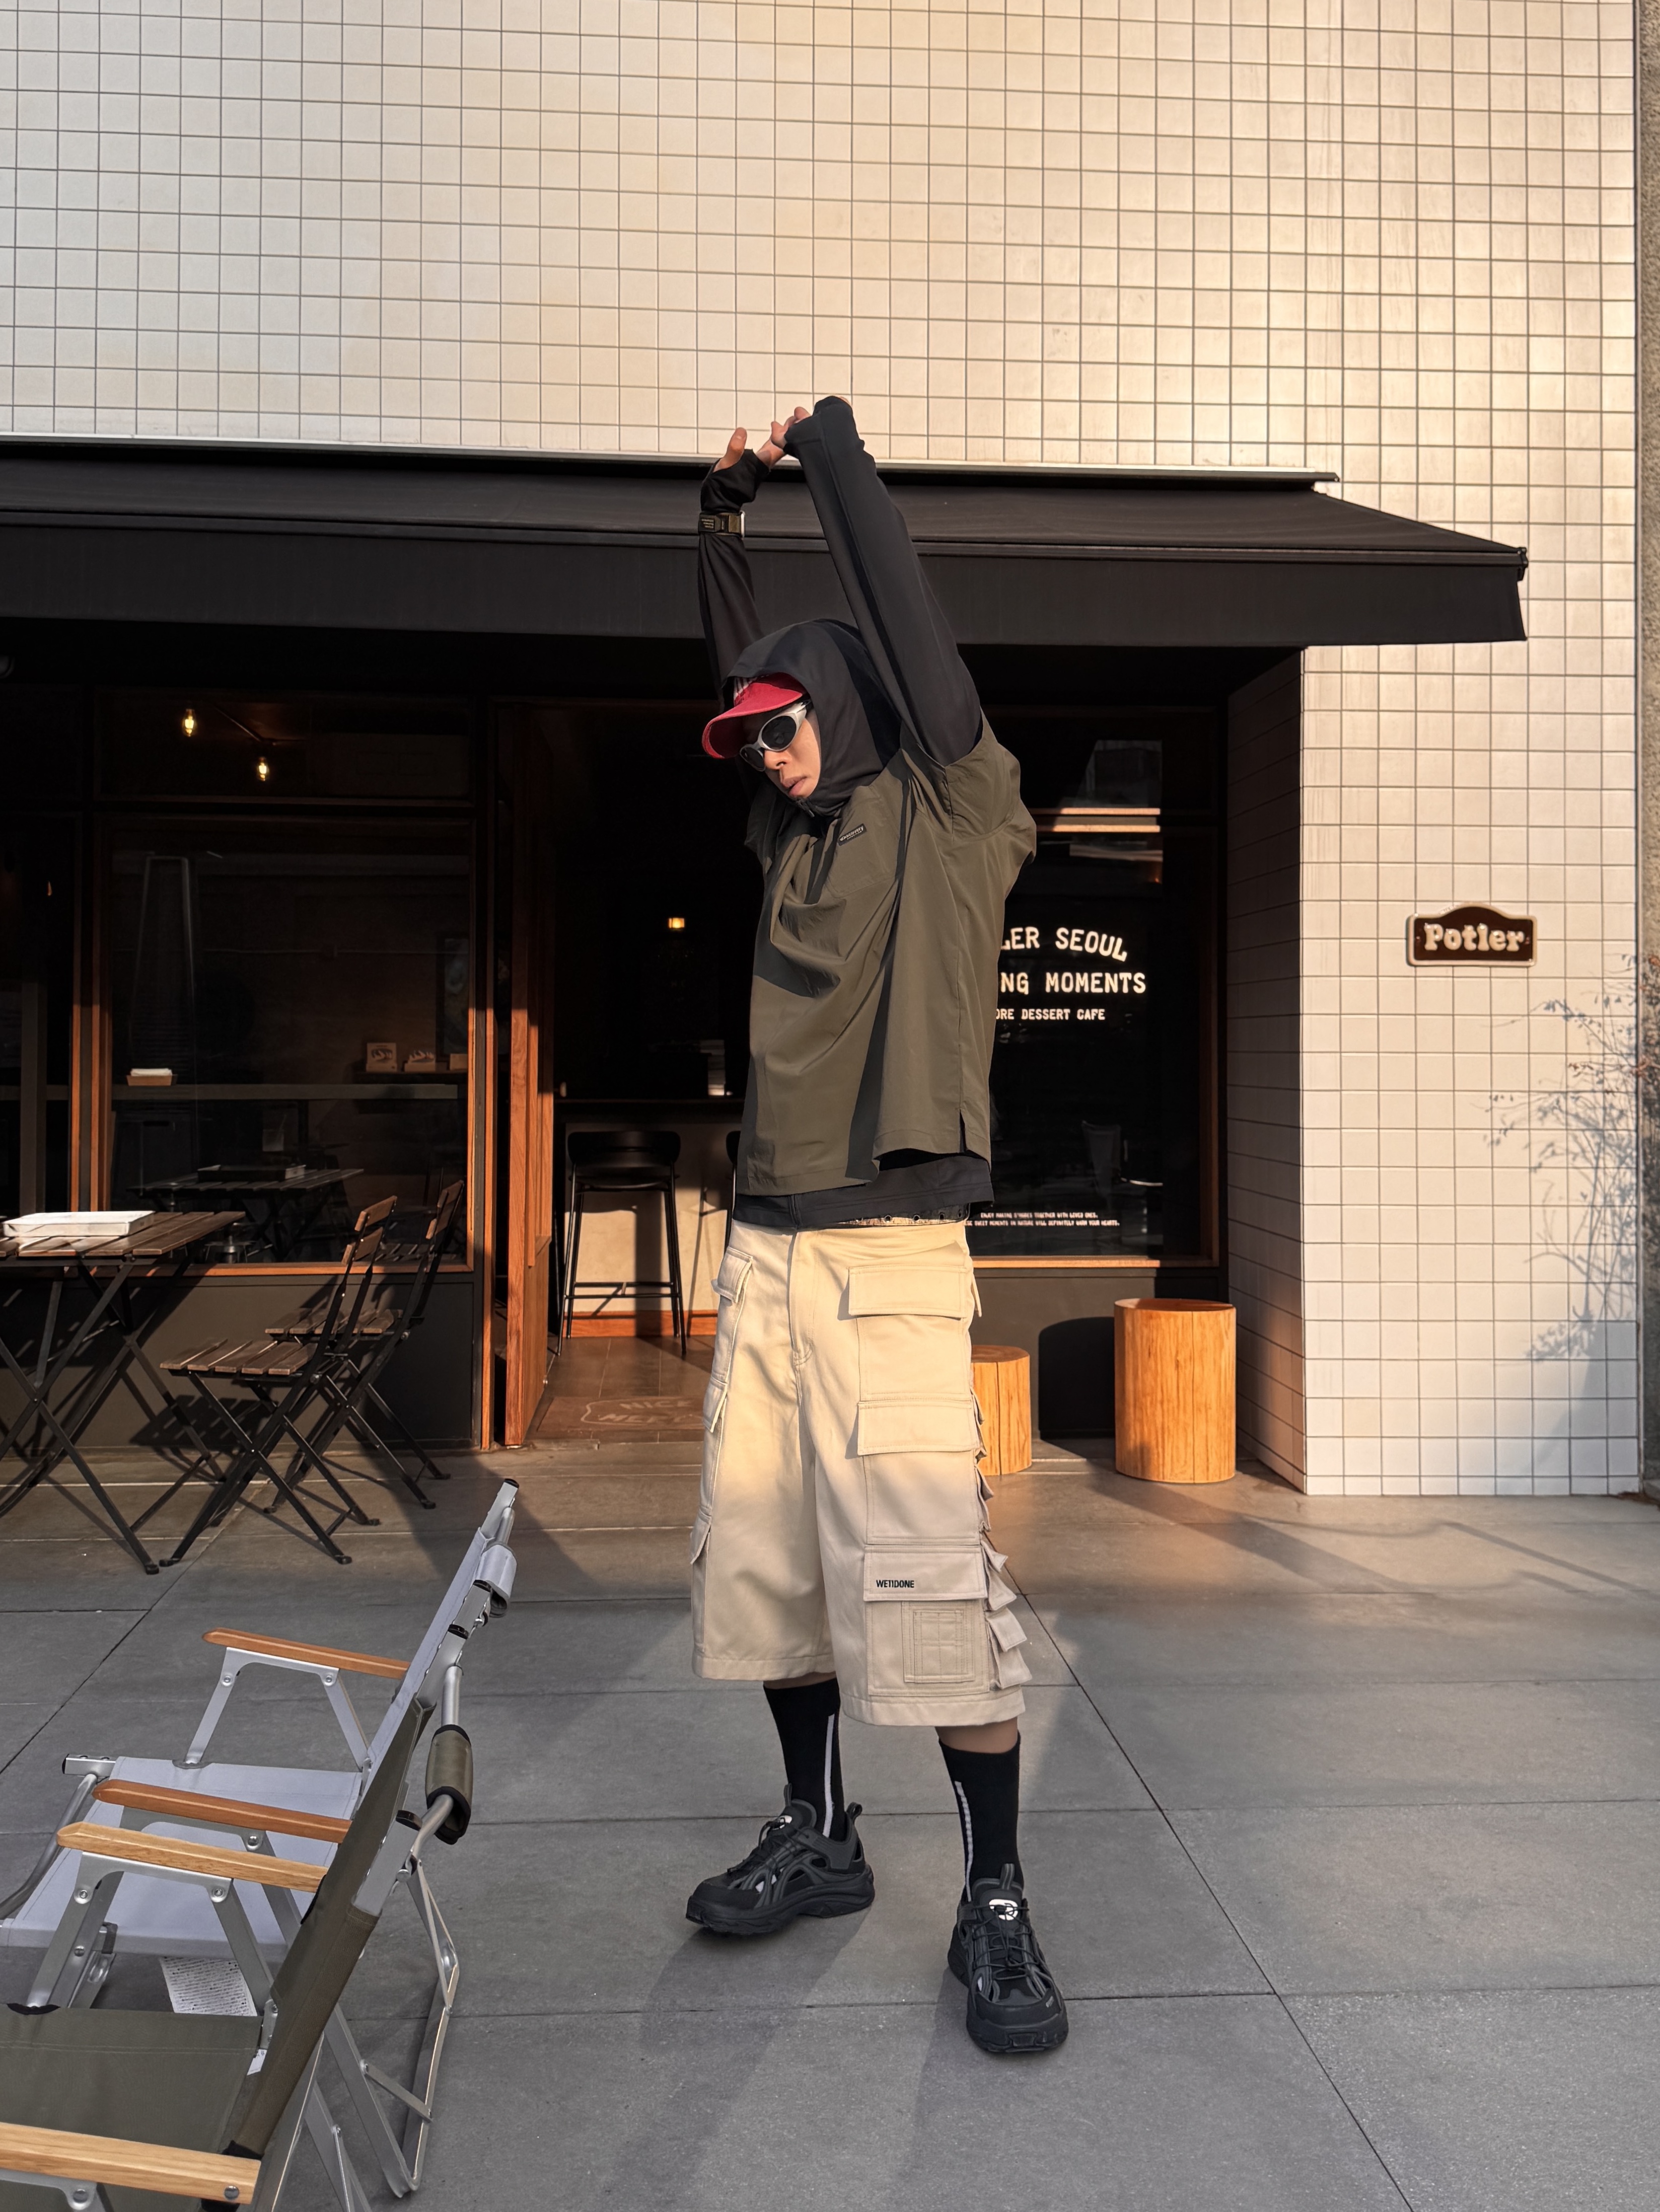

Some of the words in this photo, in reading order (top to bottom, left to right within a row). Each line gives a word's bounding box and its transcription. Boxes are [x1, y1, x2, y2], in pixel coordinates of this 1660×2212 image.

[1055, 927, 1127, 962] SEOUL
[1423, 923, 1525, 951] Potler
[1000, 972, 1029, 995] NG
[1045, 972, 1146, 994] MOMENTS
[1021, 1008, 1070, 1020] DESSERT
[1076, 1008, 1105, 1020] CAFE
[876, 1579, 914, 1588] WETIDONE
